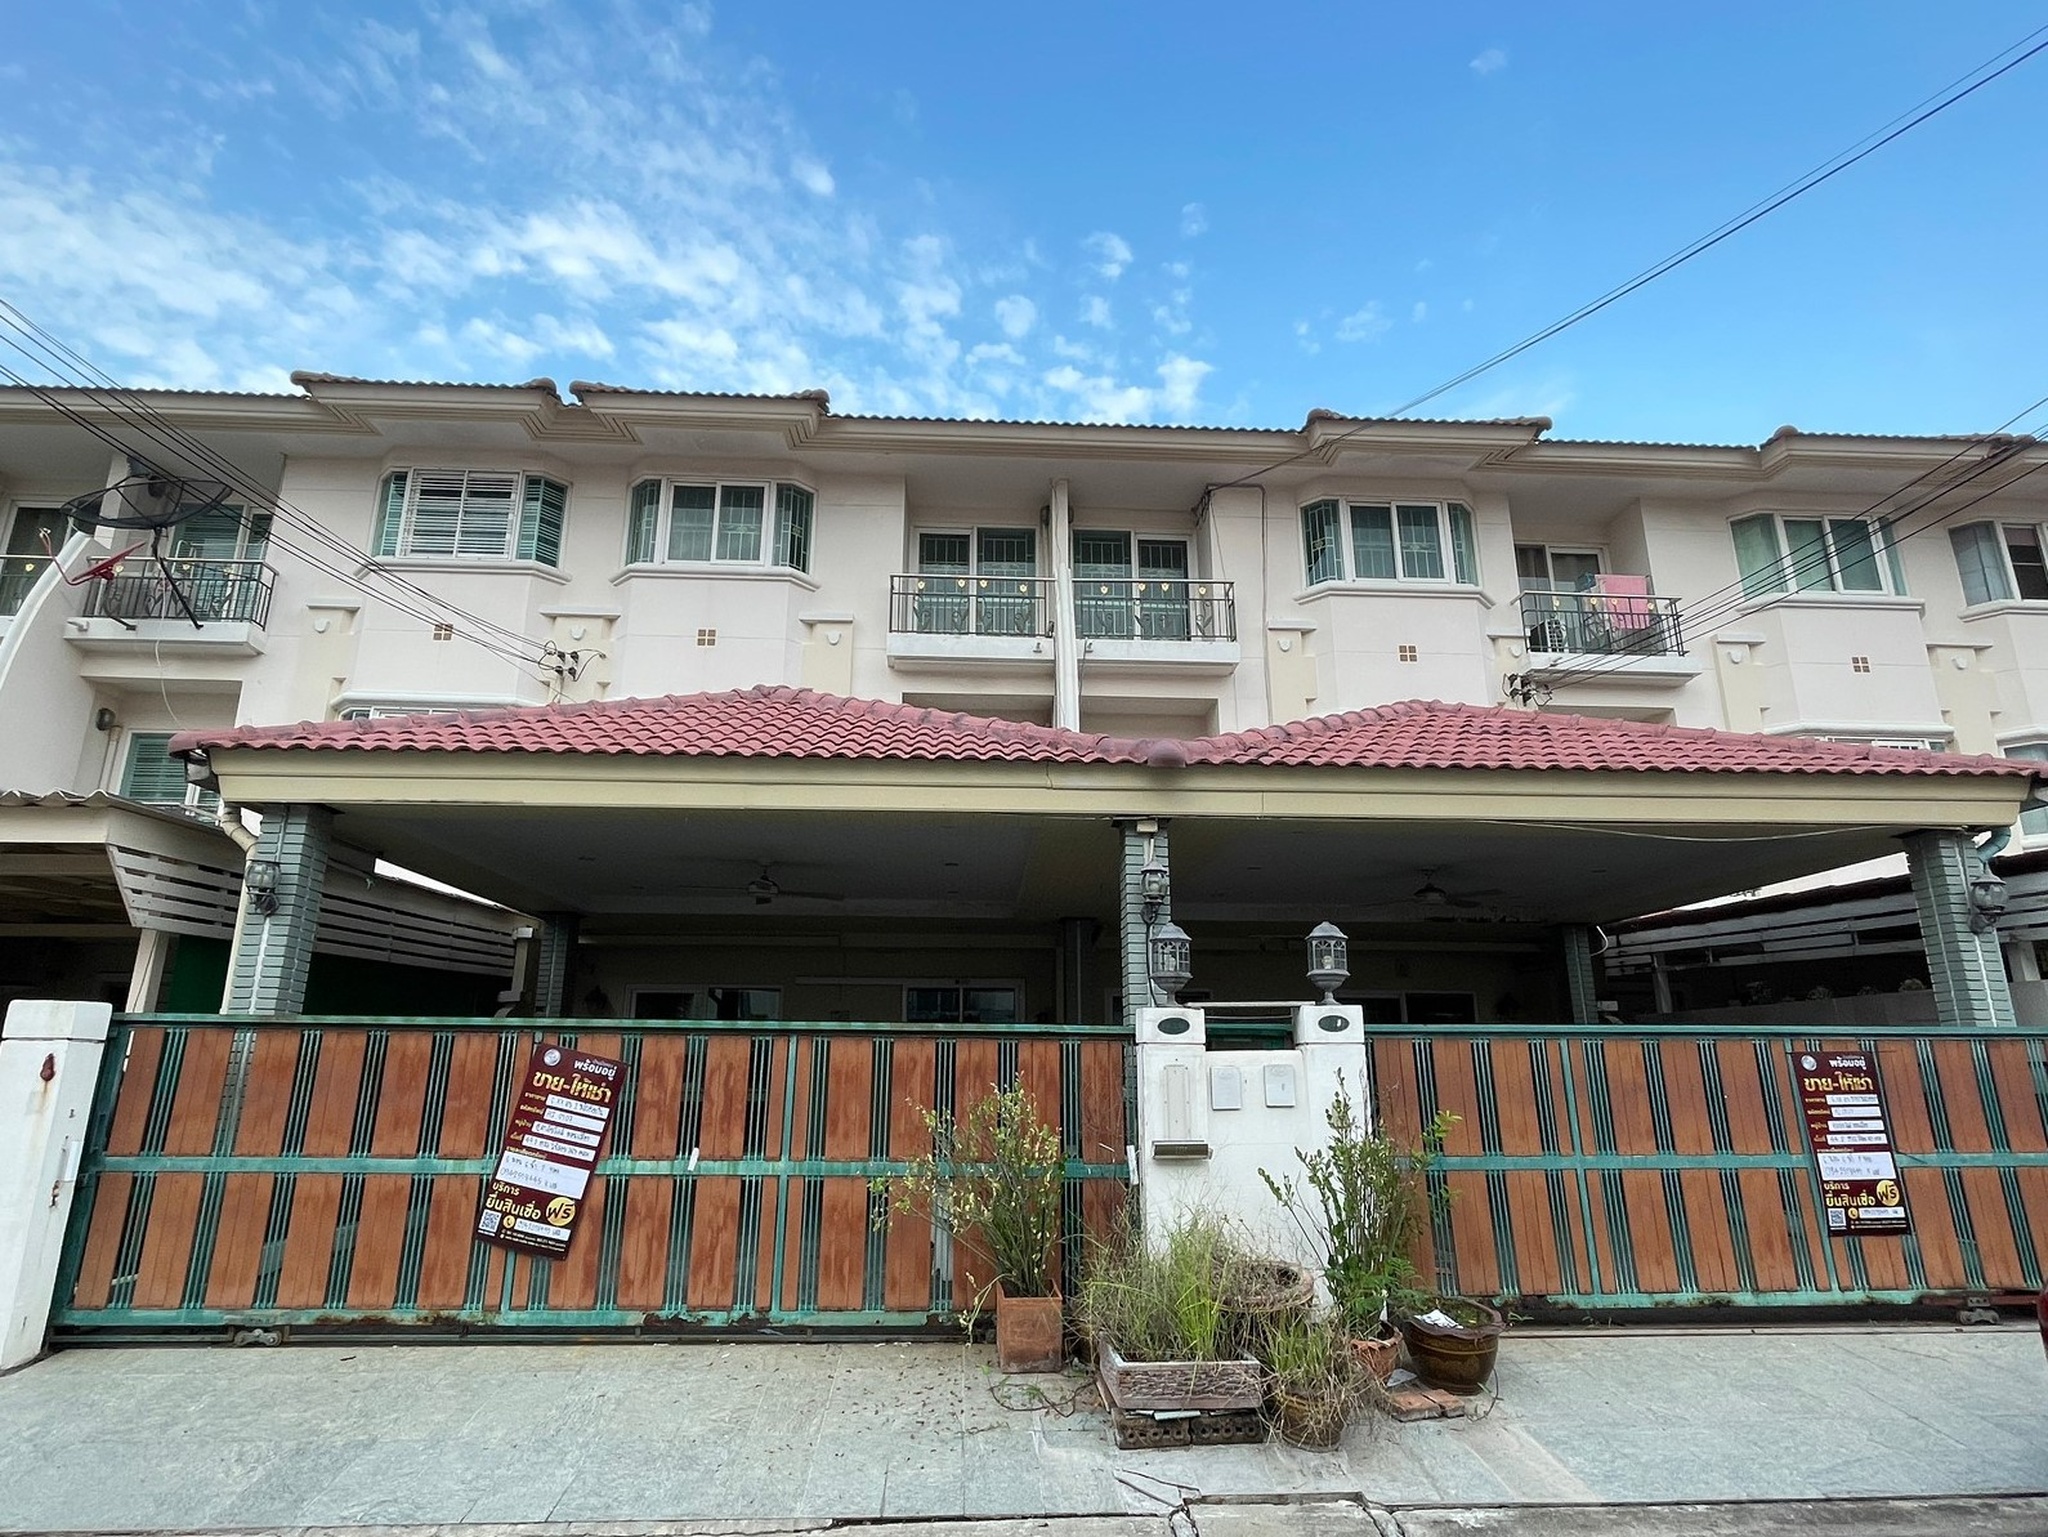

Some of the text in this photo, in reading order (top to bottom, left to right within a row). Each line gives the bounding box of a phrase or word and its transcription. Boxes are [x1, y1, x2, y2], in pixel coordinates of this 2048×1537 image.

[573, 1058, 618, 1080] พร้อมอยู่
[1828, 1056, 1867, 1071] พร้อมอยู่
[532, 1070, 613, 1103] ขาย-ให้เช่า
[1803, 1071, 1874, 1092] ขาย-ให้เช่า
[492, 1181, 520, 1196] บริการ
[1823, 1180, 1850, 1191] บริการ
[1825, 1184, 1897, 1207] ยื่นสินเชื่อ ฟรี
[486, 1191, 575, 1222] ยื่นสินเชื่อ ฟรี
